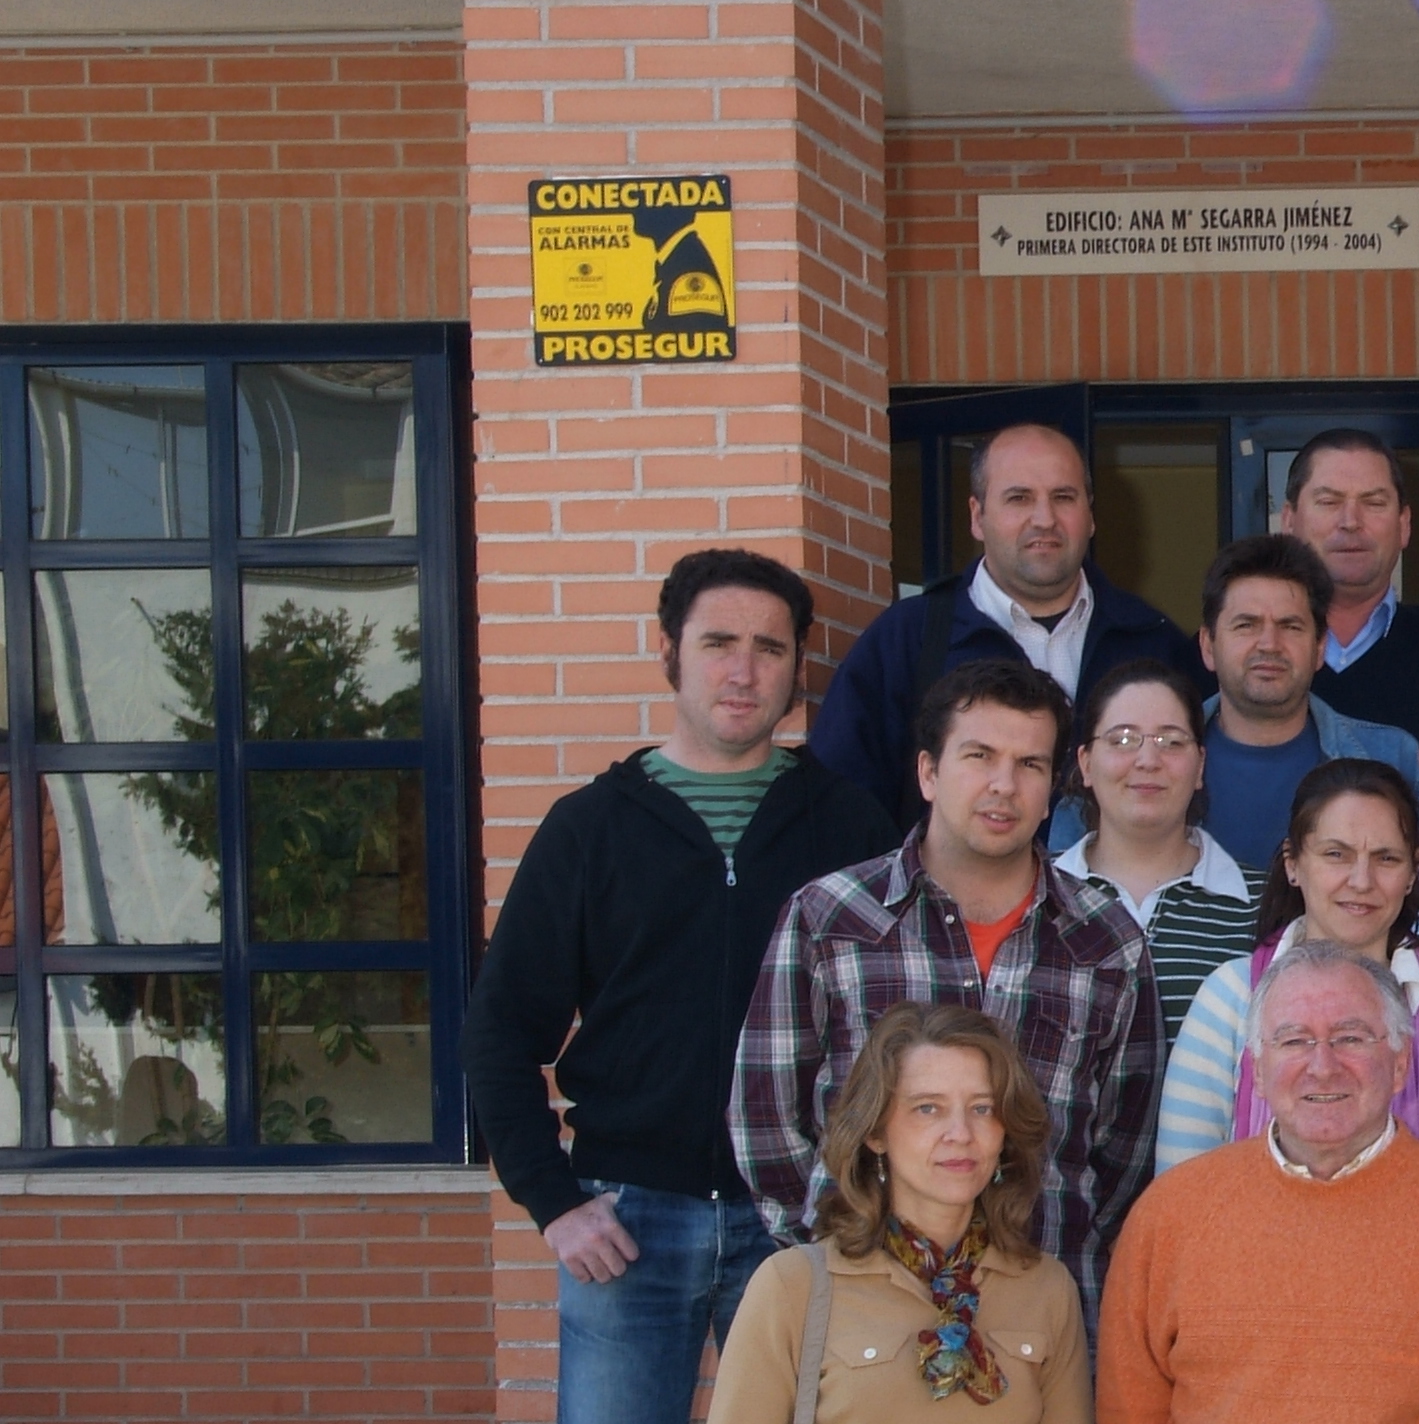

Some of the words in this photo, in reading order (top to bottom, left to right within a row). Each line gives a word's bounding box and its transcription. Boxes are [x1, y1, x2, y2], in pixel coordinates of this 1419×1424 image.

[536, 180, 725, 210] CONECTADA
[1046, 210, 1122, 233] EDIFICIO:
[1129, 209, 1164, 231] ANA
[1200, 207, 1277, 229] SEGARRA
[1283, 199, 1353, 233] JIMÉNEZ
[538, 226, 561, 235] CON
[564, 225, 612, 234] CENTRAL
[616, 224, 629, 232] DE
[540, 234, 631, 250] ALARMAS
[1017, 239, 1077, 256] PRIMERA
[1081, 237, 1156, 255] DIRECTORA
[1161, 237, 1178, 253] DE
[1183, 236, 1212, 252] ESTE
[1217, 235, 1286, 252] INSTITUTO
[1291, 234, 1329, 255] (1994
[1343, 233, 1382, 254] 2004)
[540, 304, 568, 321] 902
[573, 303, 601, 320] 202
[605, 302, 633, 320] 999
[543, 332, 732, 362] PROSEGUR
